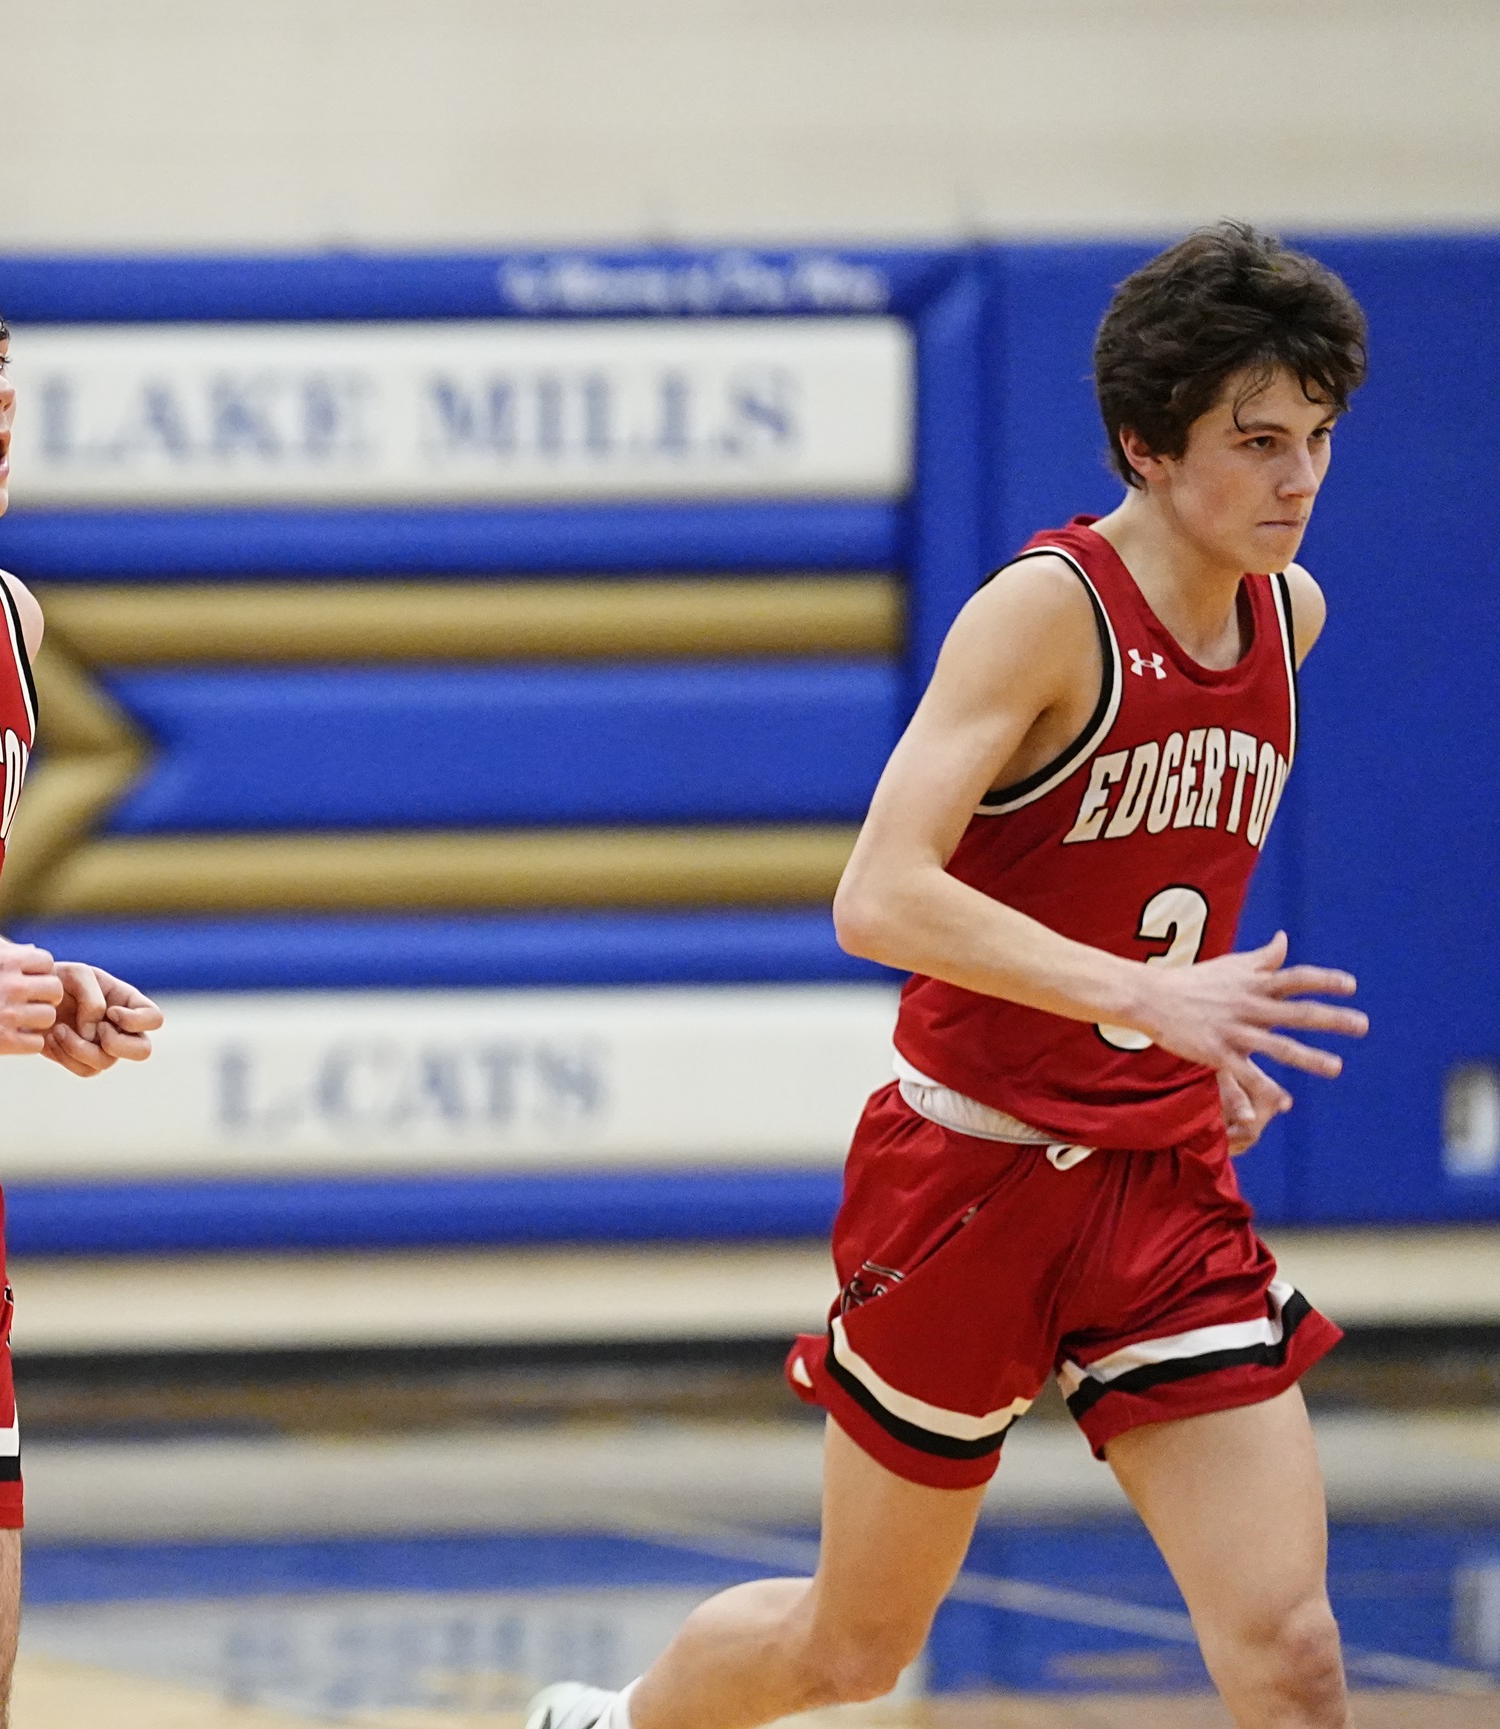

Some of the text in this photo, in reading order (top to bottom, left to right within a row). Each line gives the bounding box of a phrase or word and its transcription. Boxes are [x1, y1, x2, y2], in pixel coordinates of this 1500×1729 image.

[35, 370, 804, 465] LAKE MILLS
[1061, 727, 1290, 852] EDGERTO
